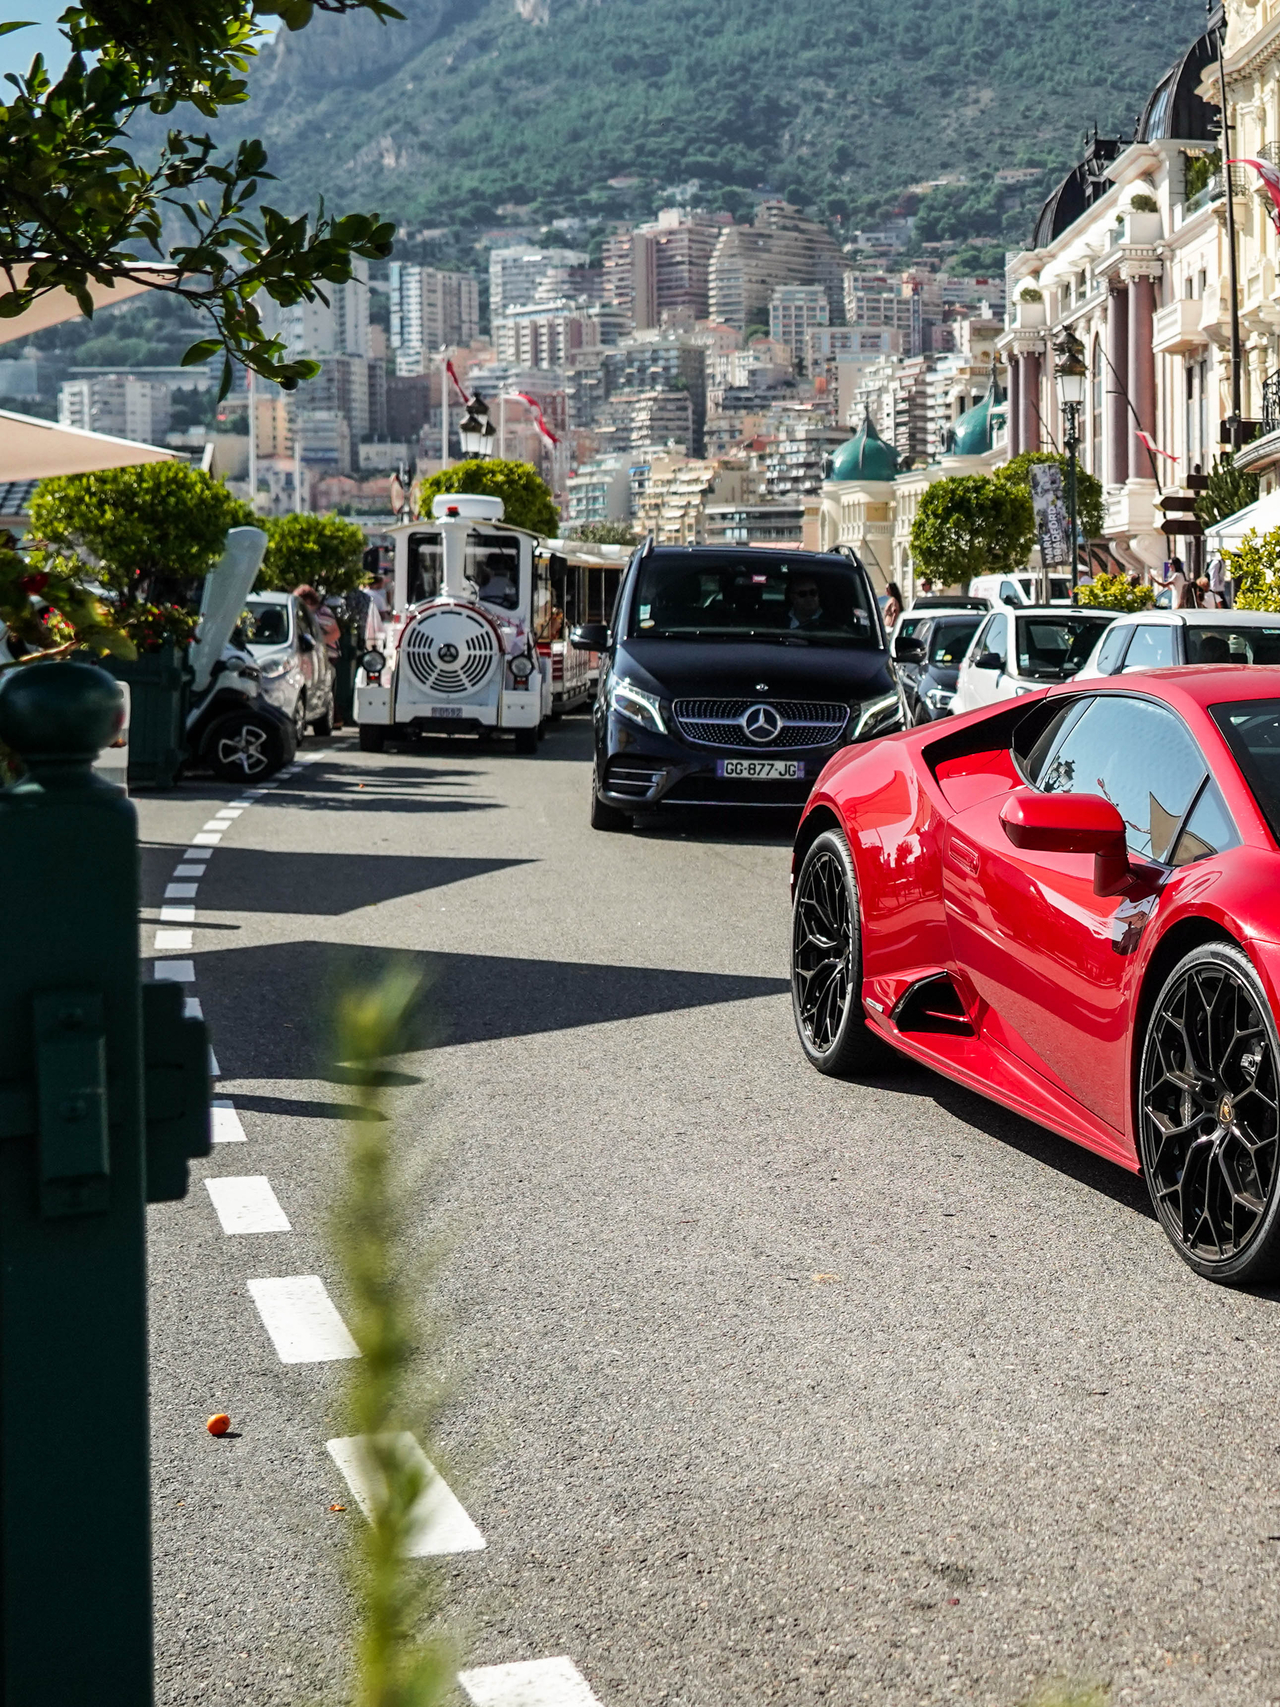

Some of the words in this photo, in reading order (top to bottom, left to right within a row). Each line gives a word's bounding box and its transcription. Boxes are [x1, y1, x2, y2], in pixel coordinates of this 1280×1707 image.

[1042, 533, 1054, 564] MARK
[1048, 505, 1063, 563] BRADFORD
[725, 762, 797, 777] GG-877-JG
